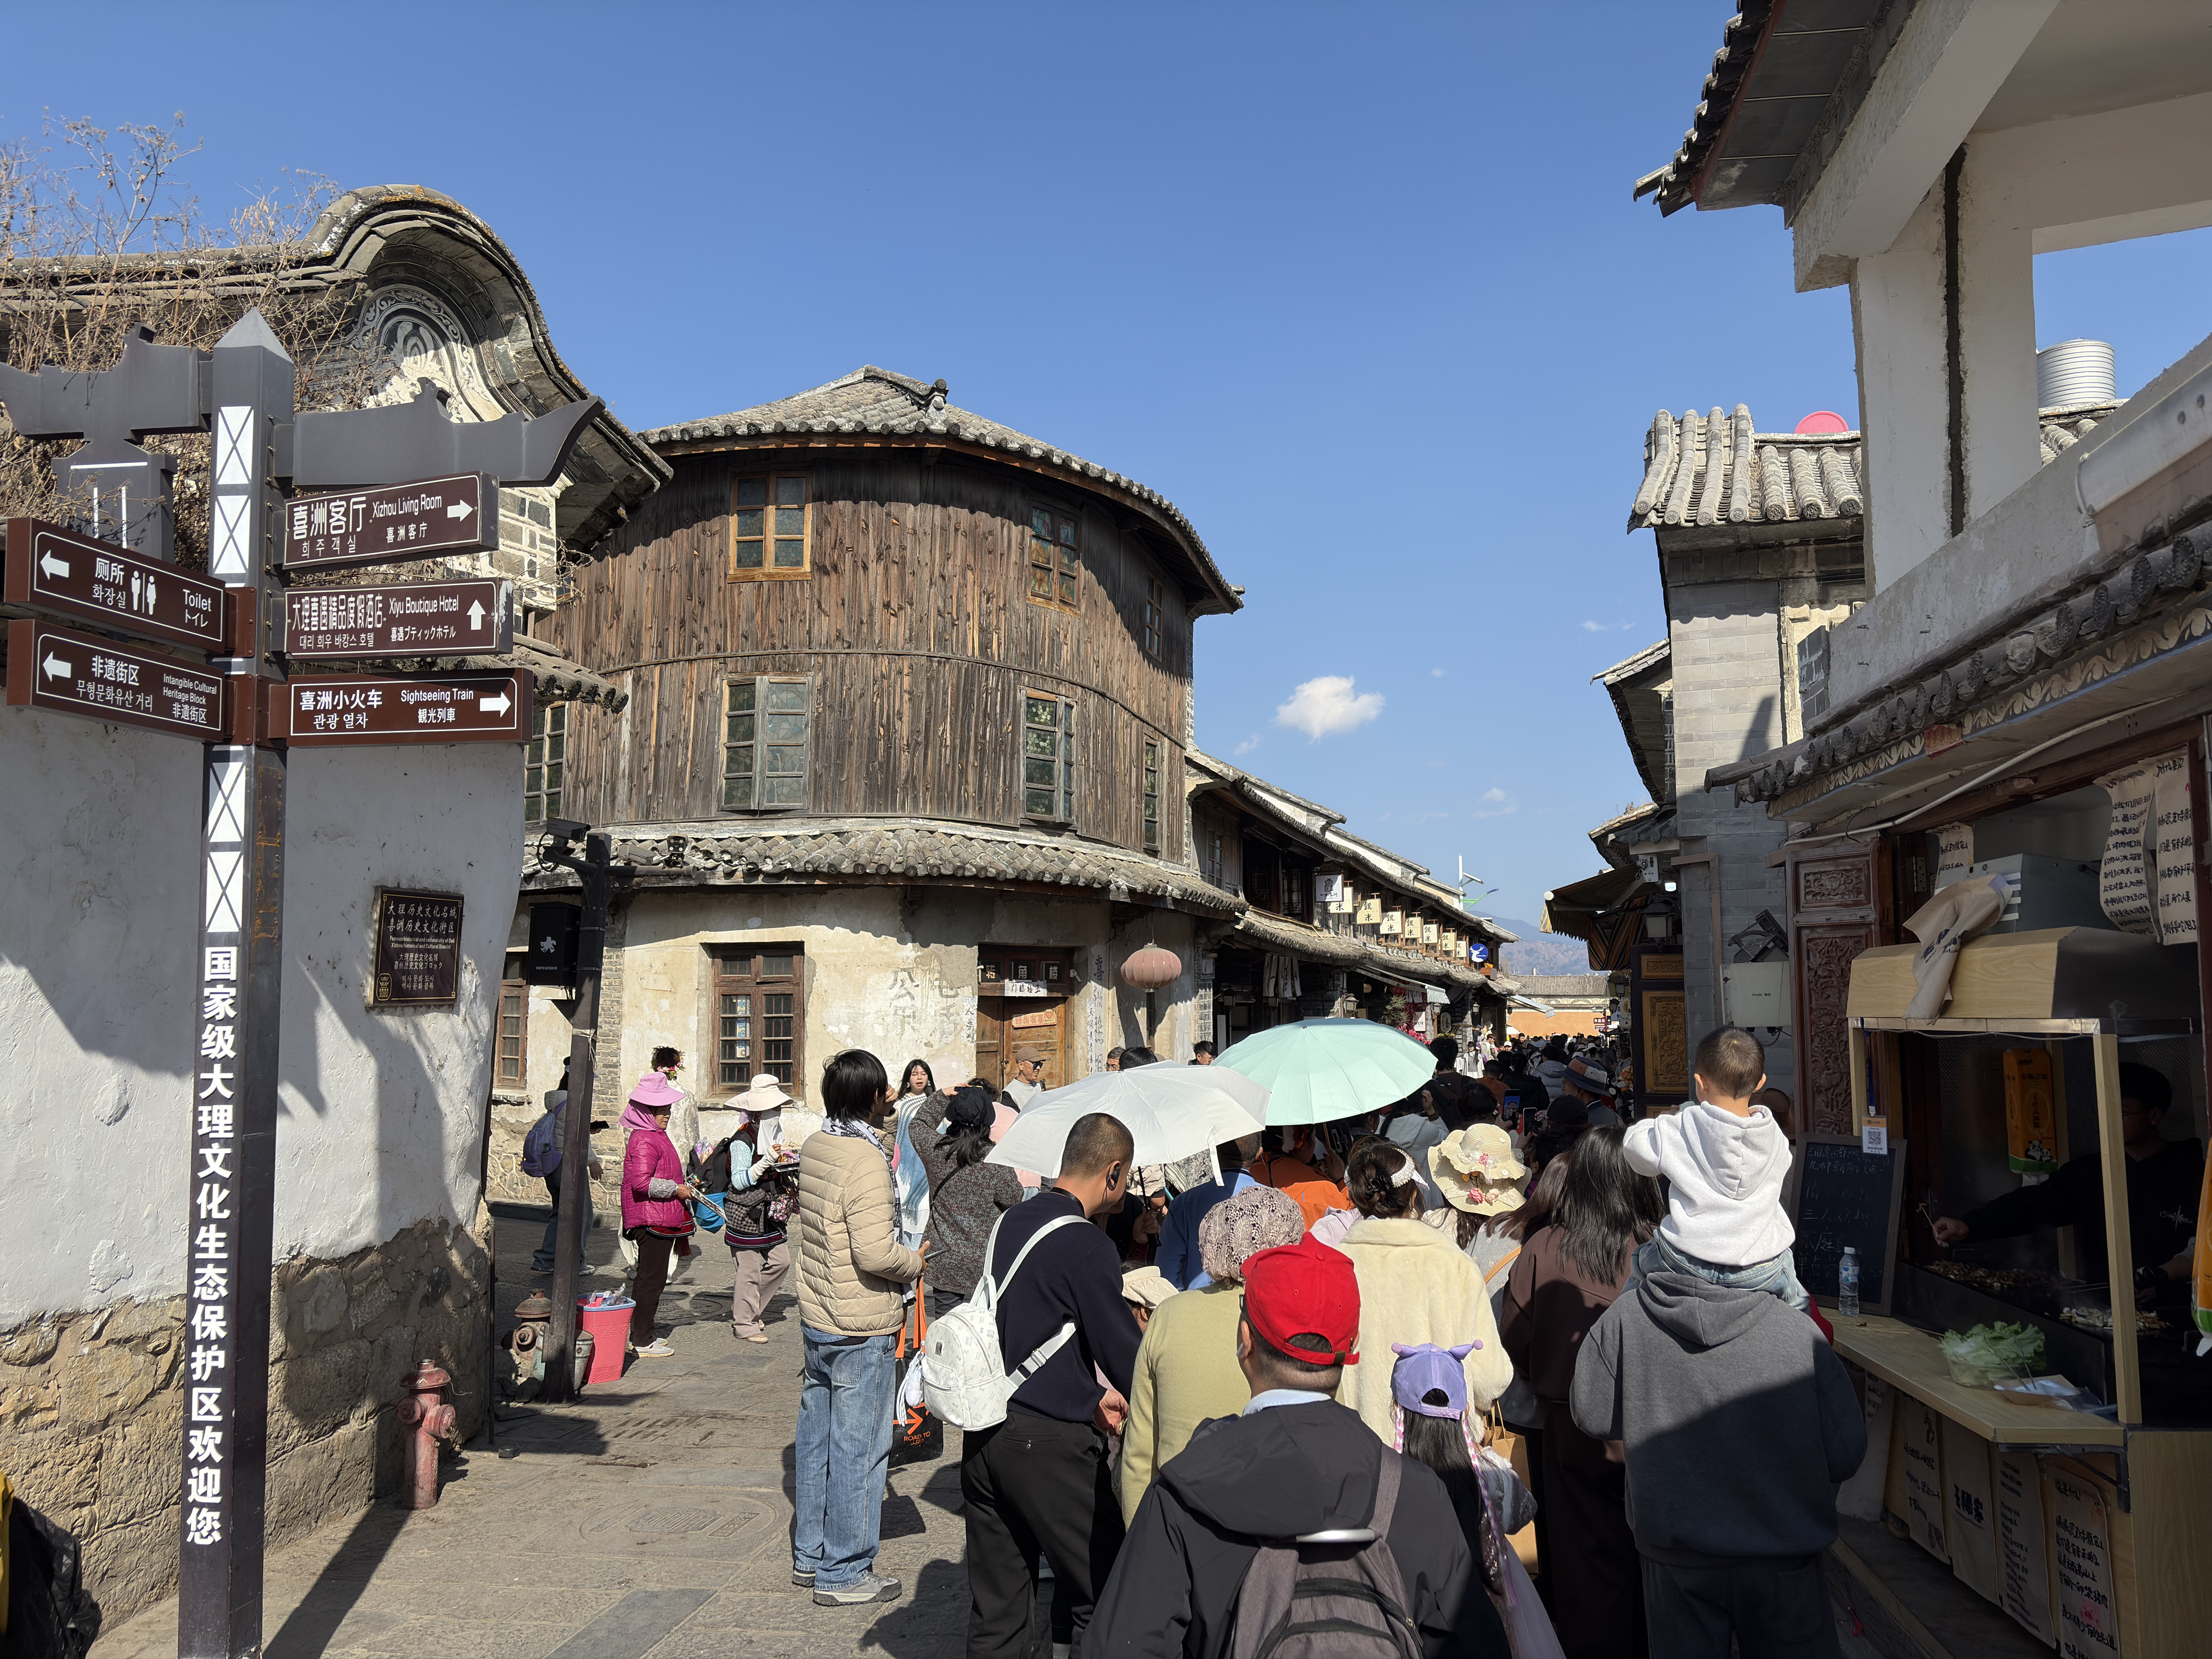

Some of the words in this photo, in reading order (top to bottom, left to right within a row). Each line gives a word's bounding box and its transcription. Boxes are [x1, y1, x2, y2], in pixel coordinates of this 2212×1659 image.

[372, 502, 397, 518] Xizhou
[399, 497, 418, 515] Living
[420, 494, 442, 512] Room
[293, 497, 366, 540] 喜洲客厅
[95, 557, 125, 586] 厕所
[92, 584, 126, 609] 화장실
[183, 589, 211, 612] Toilet
[389, 598, 404, 615] Xiyu
[406, 596, 437, 616] Boutique
[440, 594, 459, 612] Hotel
[185, 609, 208, 628] トイレ
[293, 594, 383, 631] 大理喜遇精品度假酒店
[300, 635, 314, 649] 대리
[317, 634, 332, 648] 희우
[335, 633, 357, 648] 바캉스
[359, 632, 374, 647] 호텔
[390, 625, 456, 641] 喜遇ブティックホテル
[92, 655, 139, 686] 非遗街区
[163, 673, 193, 690] Intangible
[194, 680, 217, 695] Cultural
[77, 680, 133, 708] 무형문화유산
[135, 693, 153, 712] 거리
[163, 687, 189, 703] Heritage
[190, 692, 206, 705] Block
[300, 689, 383, 711] 喜洲小火车
[401, 690, 451, 703] Sightseeing
[452, 688, 474, 701] Train
[172, 702, 207, 724] 非遺街区
[314, 713, 339, 729] 관광
[343, 712, 368, 729] 열차
[418, 708, 456, 723] 観光列車
[388, 901, 457, 919] 大理历史文化名城
[388, 917, 453, 934] 喜洲历史文化街区
[986, 964, 1058, 980] 转角楼
[186, 946, 238, 1545] 国家级大理文化生态保护区欢迎您
